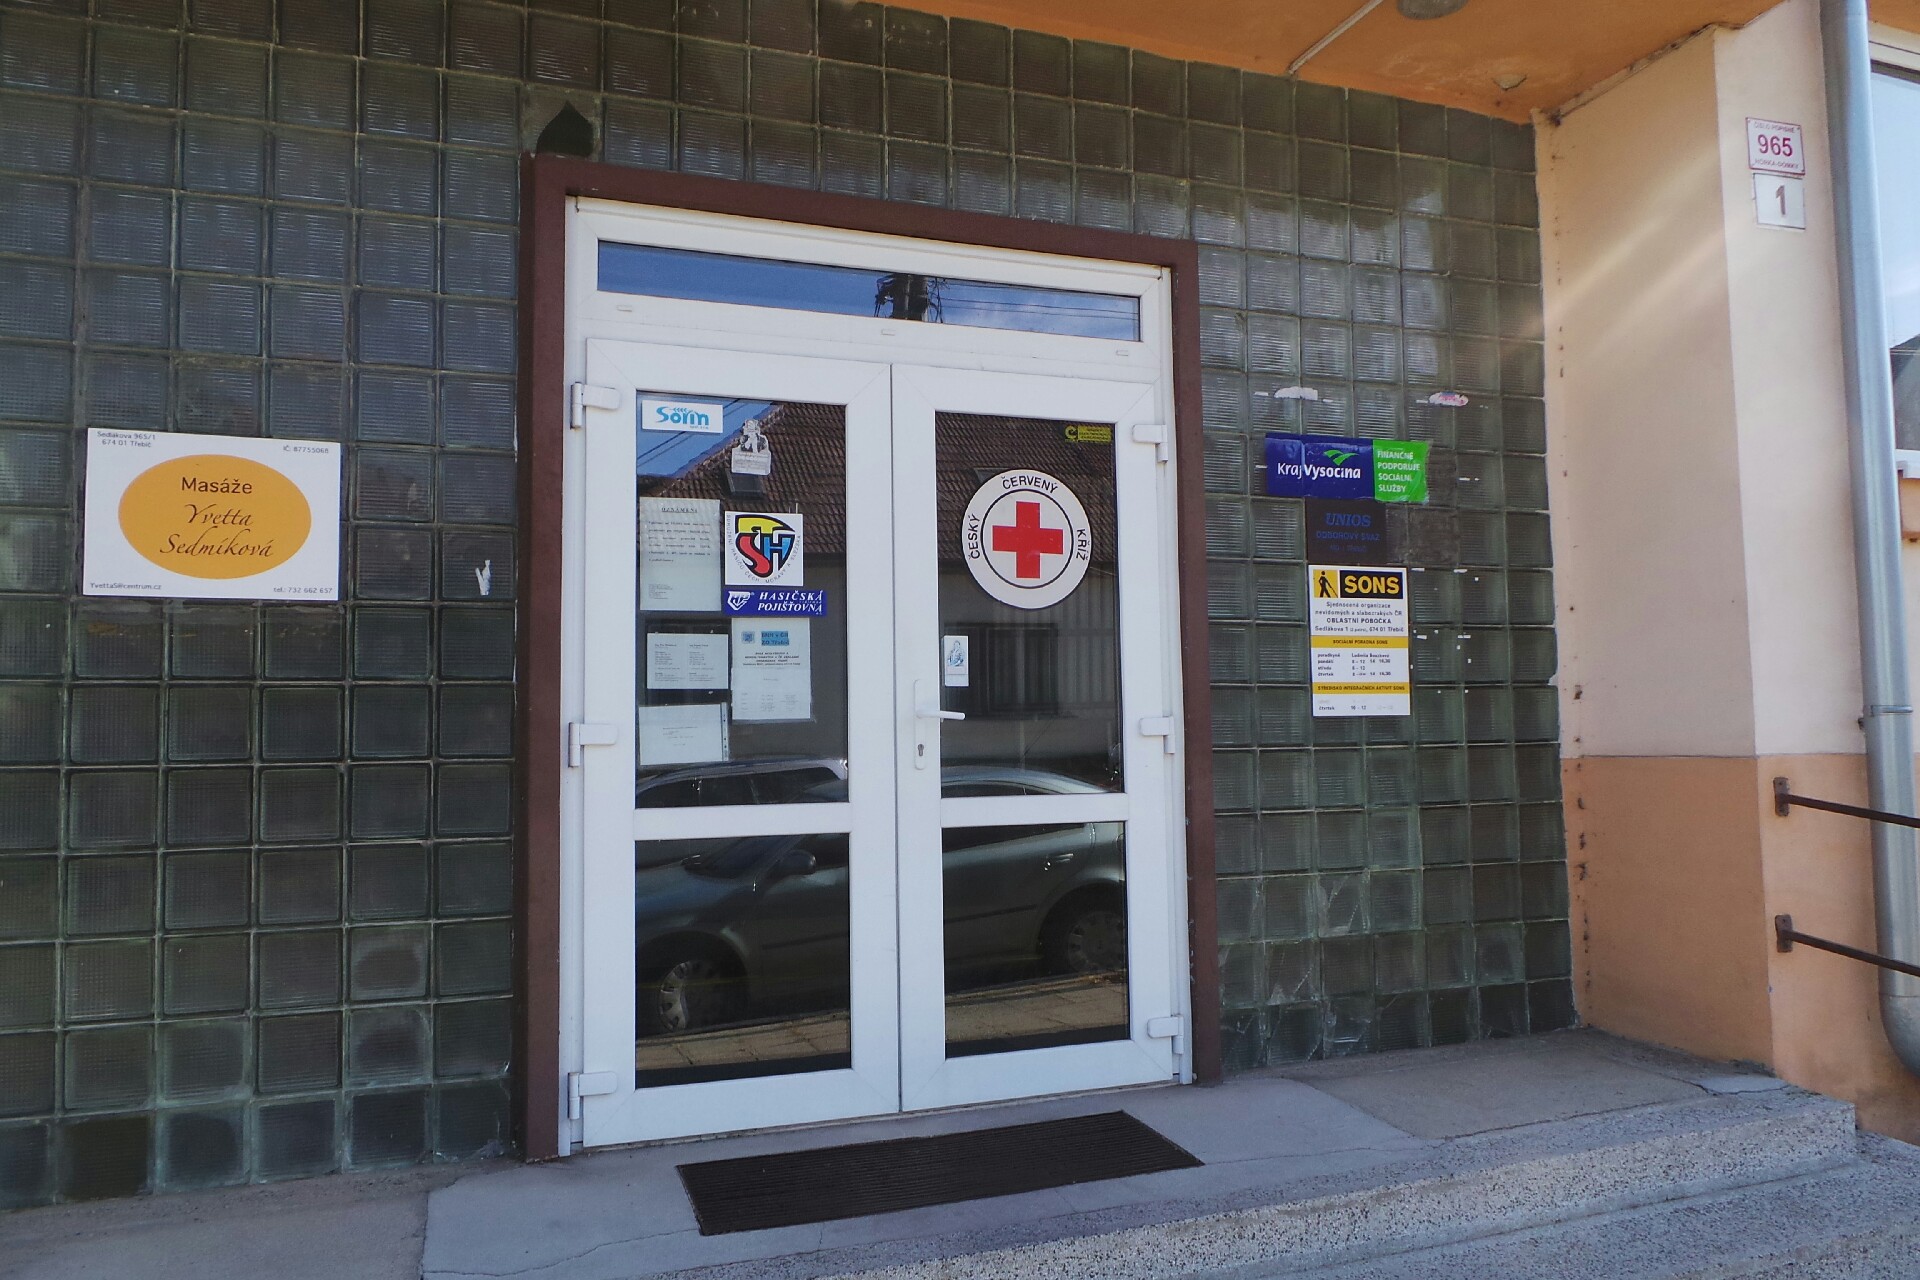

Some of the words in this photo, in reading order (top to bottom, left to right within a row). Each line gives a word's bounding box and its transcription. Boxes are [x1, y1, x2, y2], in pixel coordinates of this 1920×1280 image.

[1757, 134, 1793, 157] 965
[1776, 185, 1786, 216] 1
[134, 433, 156, 441] 965/1
[1277, 462, 1302, 480] Kraj
[1377, 462, 1421, 471] PODPORUJE
[182, 477, 253, 494] Masáže
[1378, 483, 1407, 492] SLUŽBY
[184, 503, 254, 526] Yvetta
[967, 513, 980, 560] ČESKÝ
[1001, 475, 1058, 494] ČERVENÝ
[1076, 528, 1090, 561] KŘÍŽ
[1325, 512, 1372, 527] UNIOS
[160, 526, 274, 558] Sedmíková
[1344, 575, 1400, 595] SONS
[759, 589, 823, 601] HASIČSKÁ
